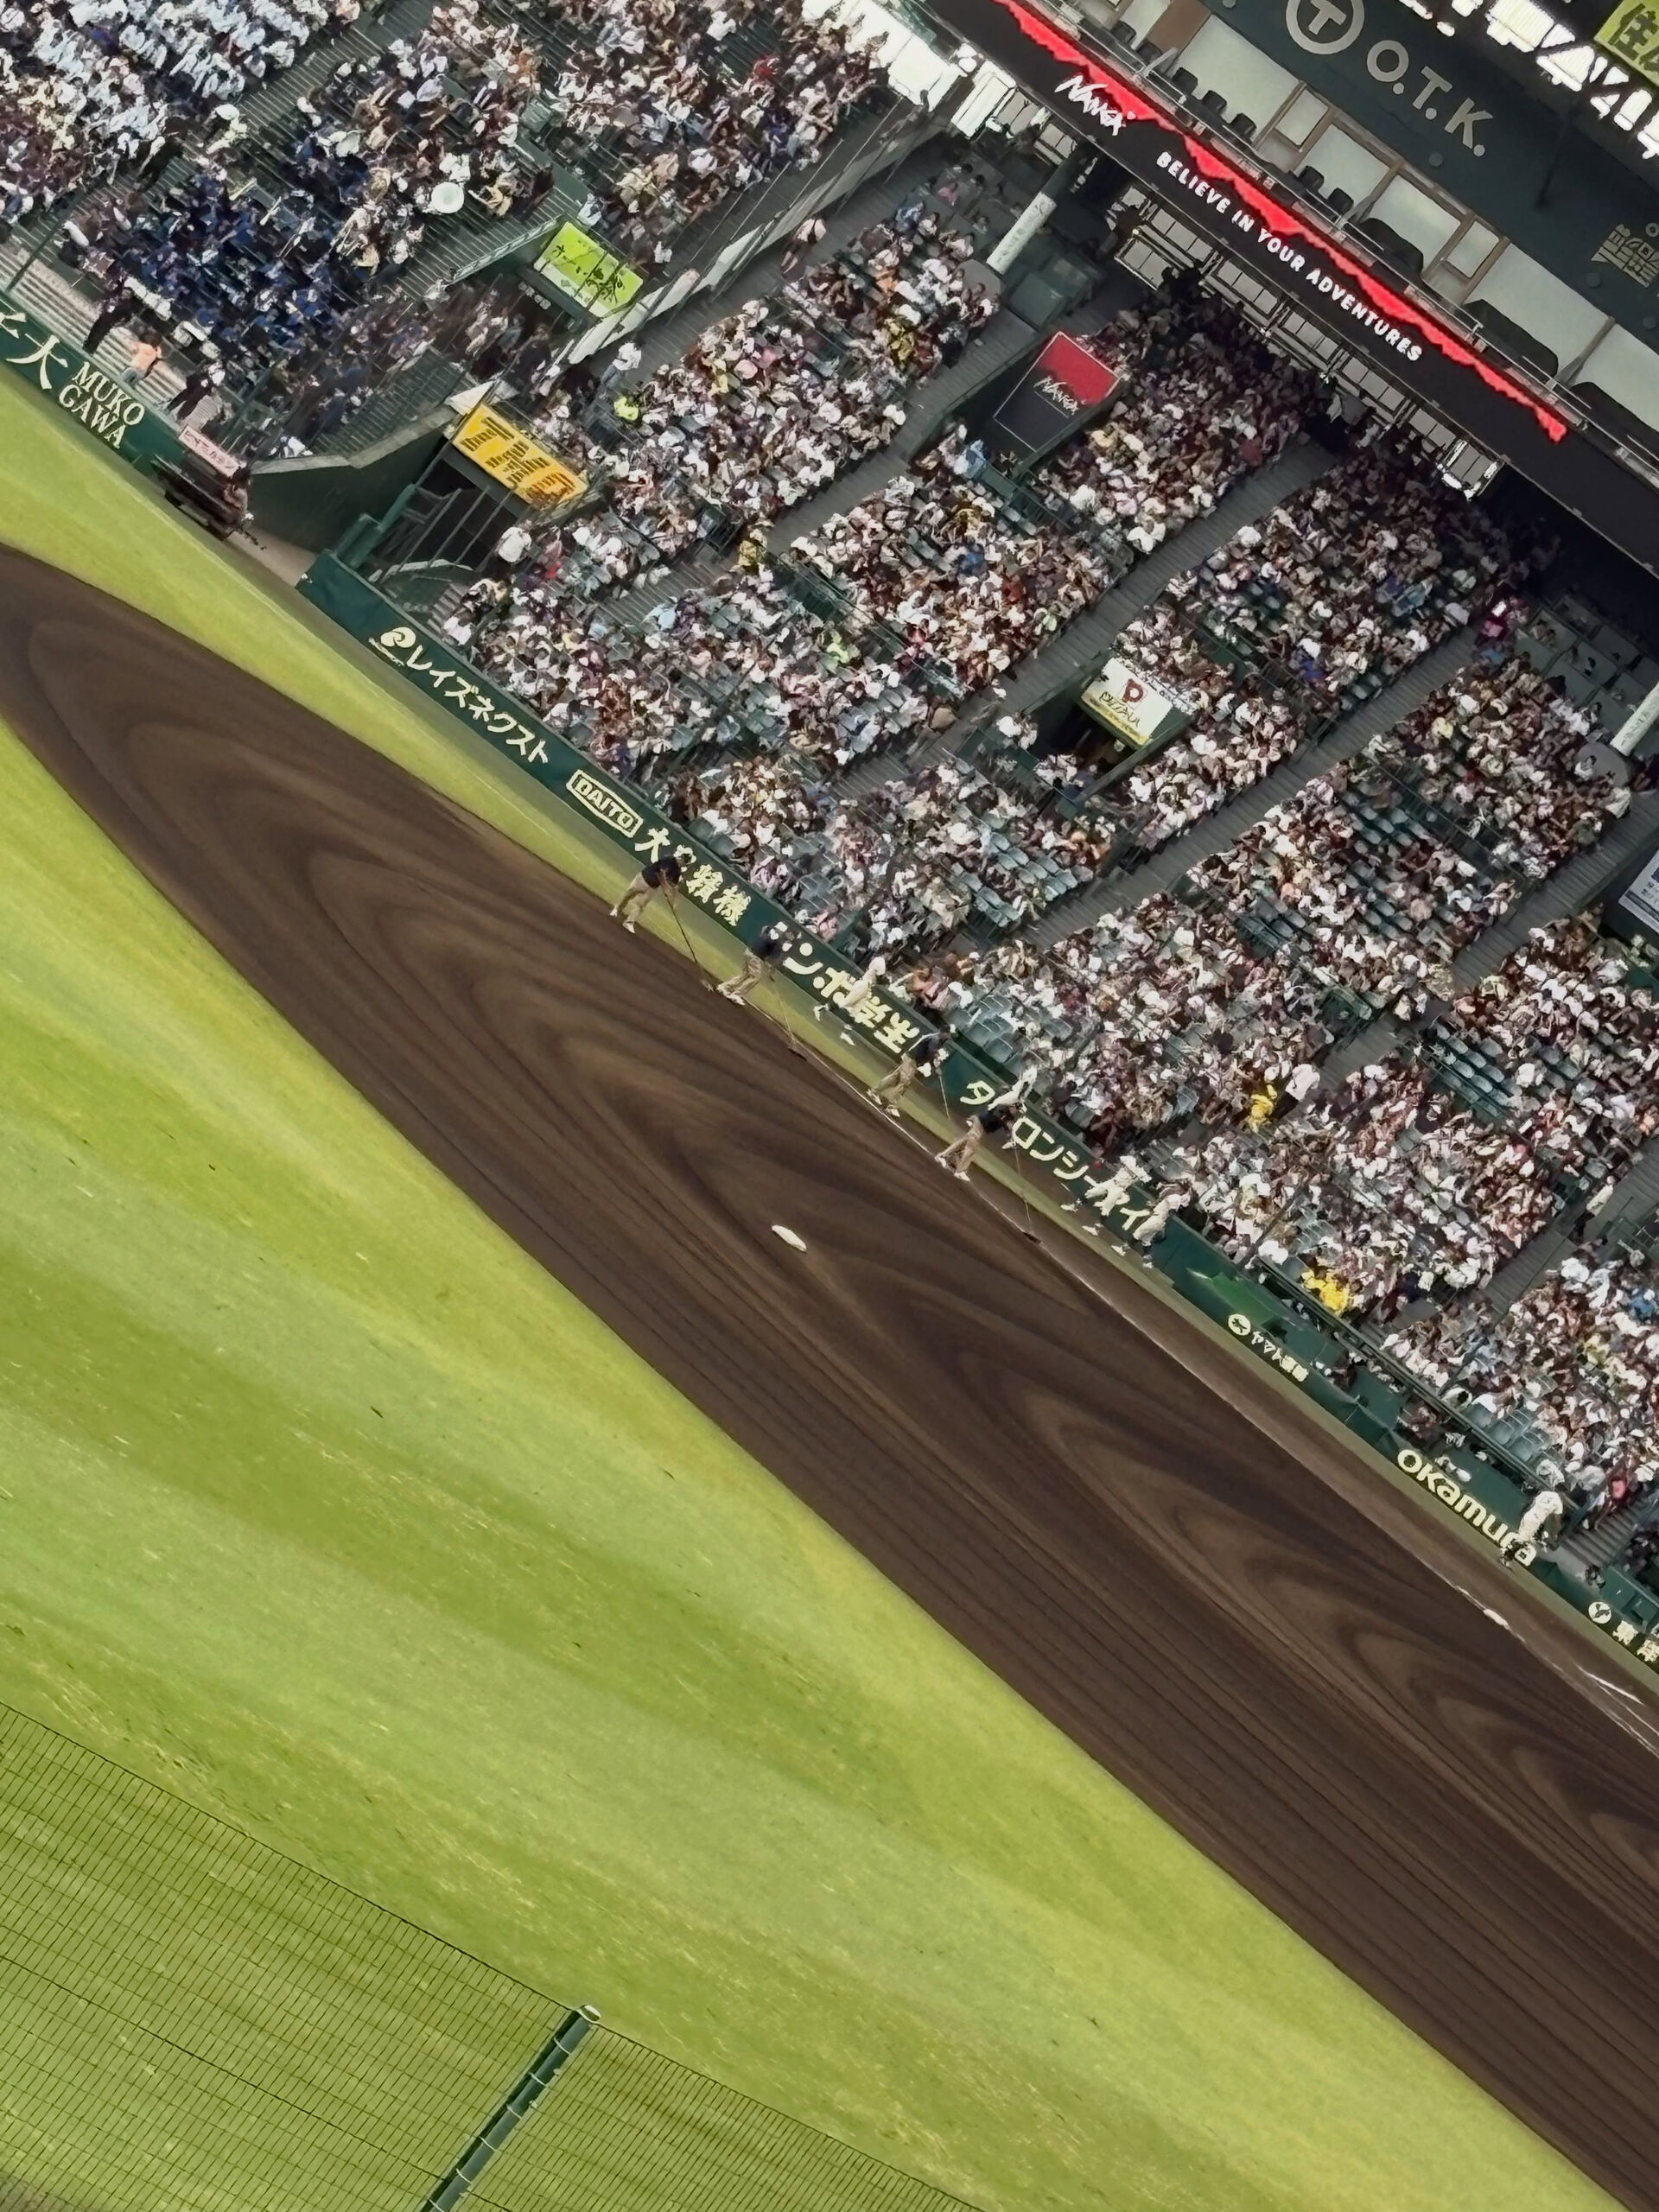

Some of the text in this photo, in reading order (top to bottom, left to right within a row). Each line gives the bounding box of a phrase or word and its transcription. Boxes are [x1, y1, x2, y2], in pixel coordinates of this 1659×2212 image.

[1366, 40, 1494, 157] O.T.K.
[1156, 151, 1423, 361] BELIEVE IN YOUR ADVENTURES
[59, 385, 128, 448] GAWA
[72, 361, 145, 426] MUKO
[406, 645, 549, 763] レイズネクスト
[574, 777, 635, 830] DAITO
[960, 1081, 1150, 1231] タロンシーイ
